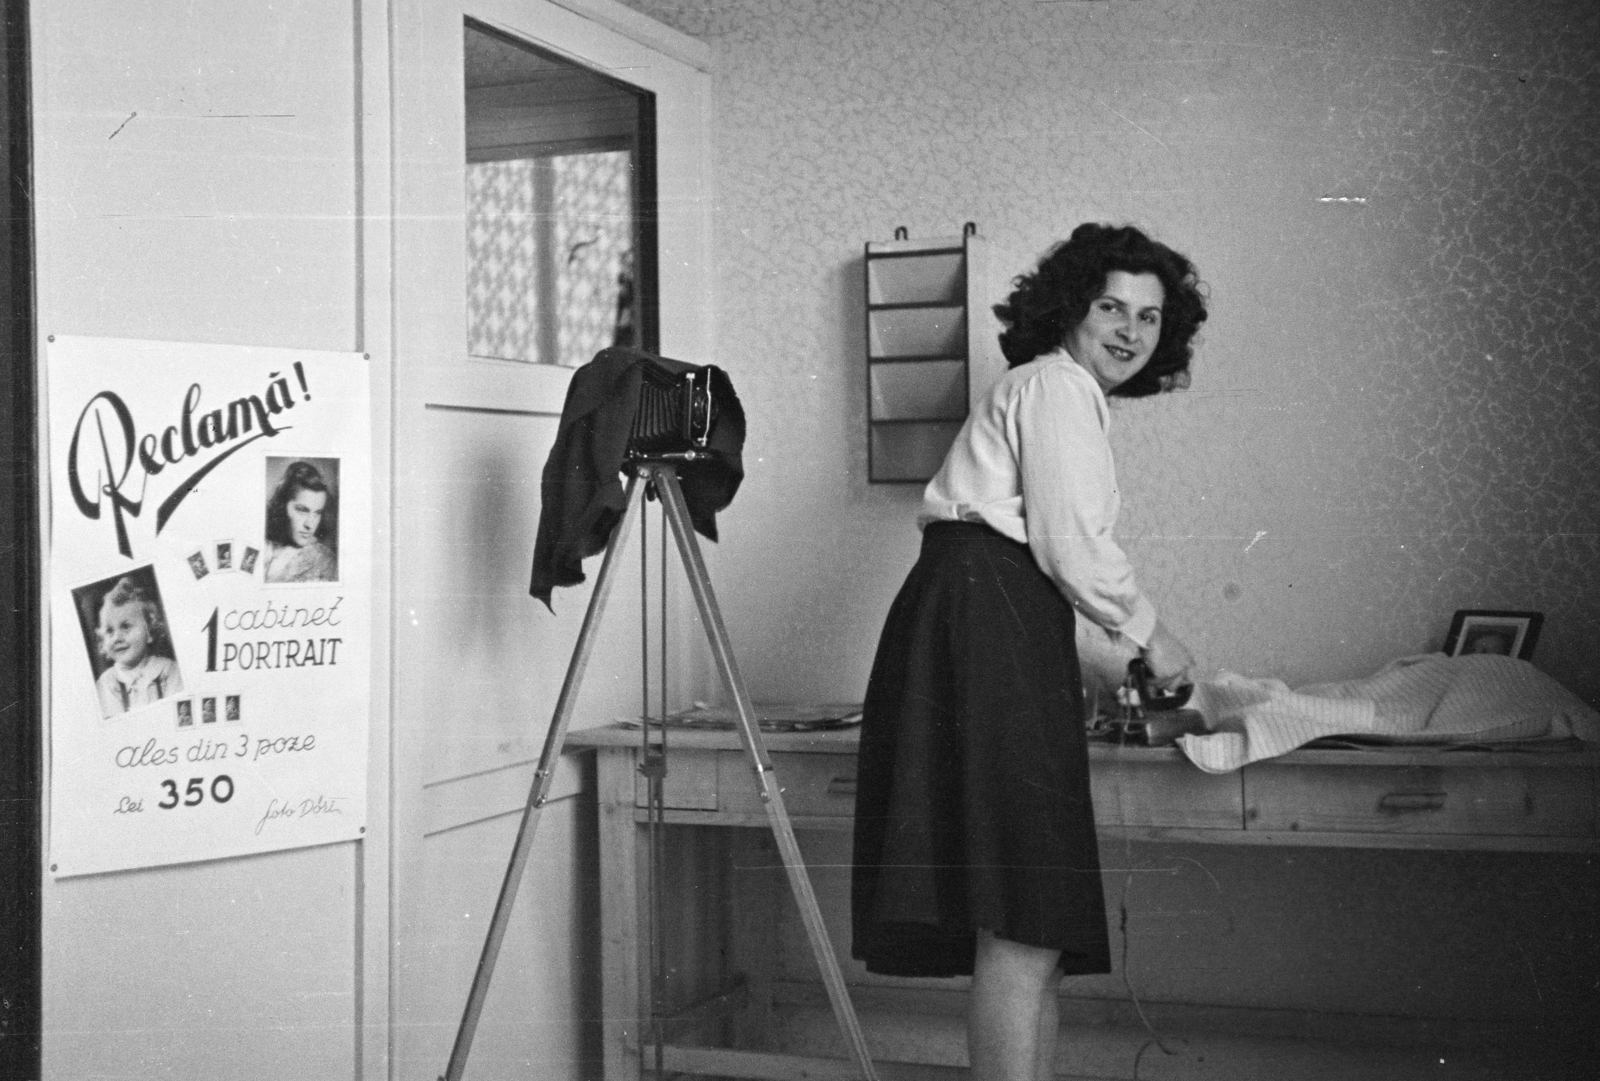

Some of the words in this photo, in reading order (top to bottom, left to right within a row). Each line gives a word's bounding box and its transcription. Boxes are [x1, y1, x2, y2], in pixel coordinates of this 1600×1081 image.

[68, 360, 312, 560] Reclamă!
[200, 606, 219, 673] 1
[223, 596, 344, 631] cabinet
[222, 638, 343, 671] PORTRAIT
[115, 737, 179, 768] ales
[186, 738, 229, 762] din
[234, 733, 250, 758] 3
[253, 733, 316, 761] poze
[113, 796, 145, 814] Lei
[157, 774, 235, 810] 350
